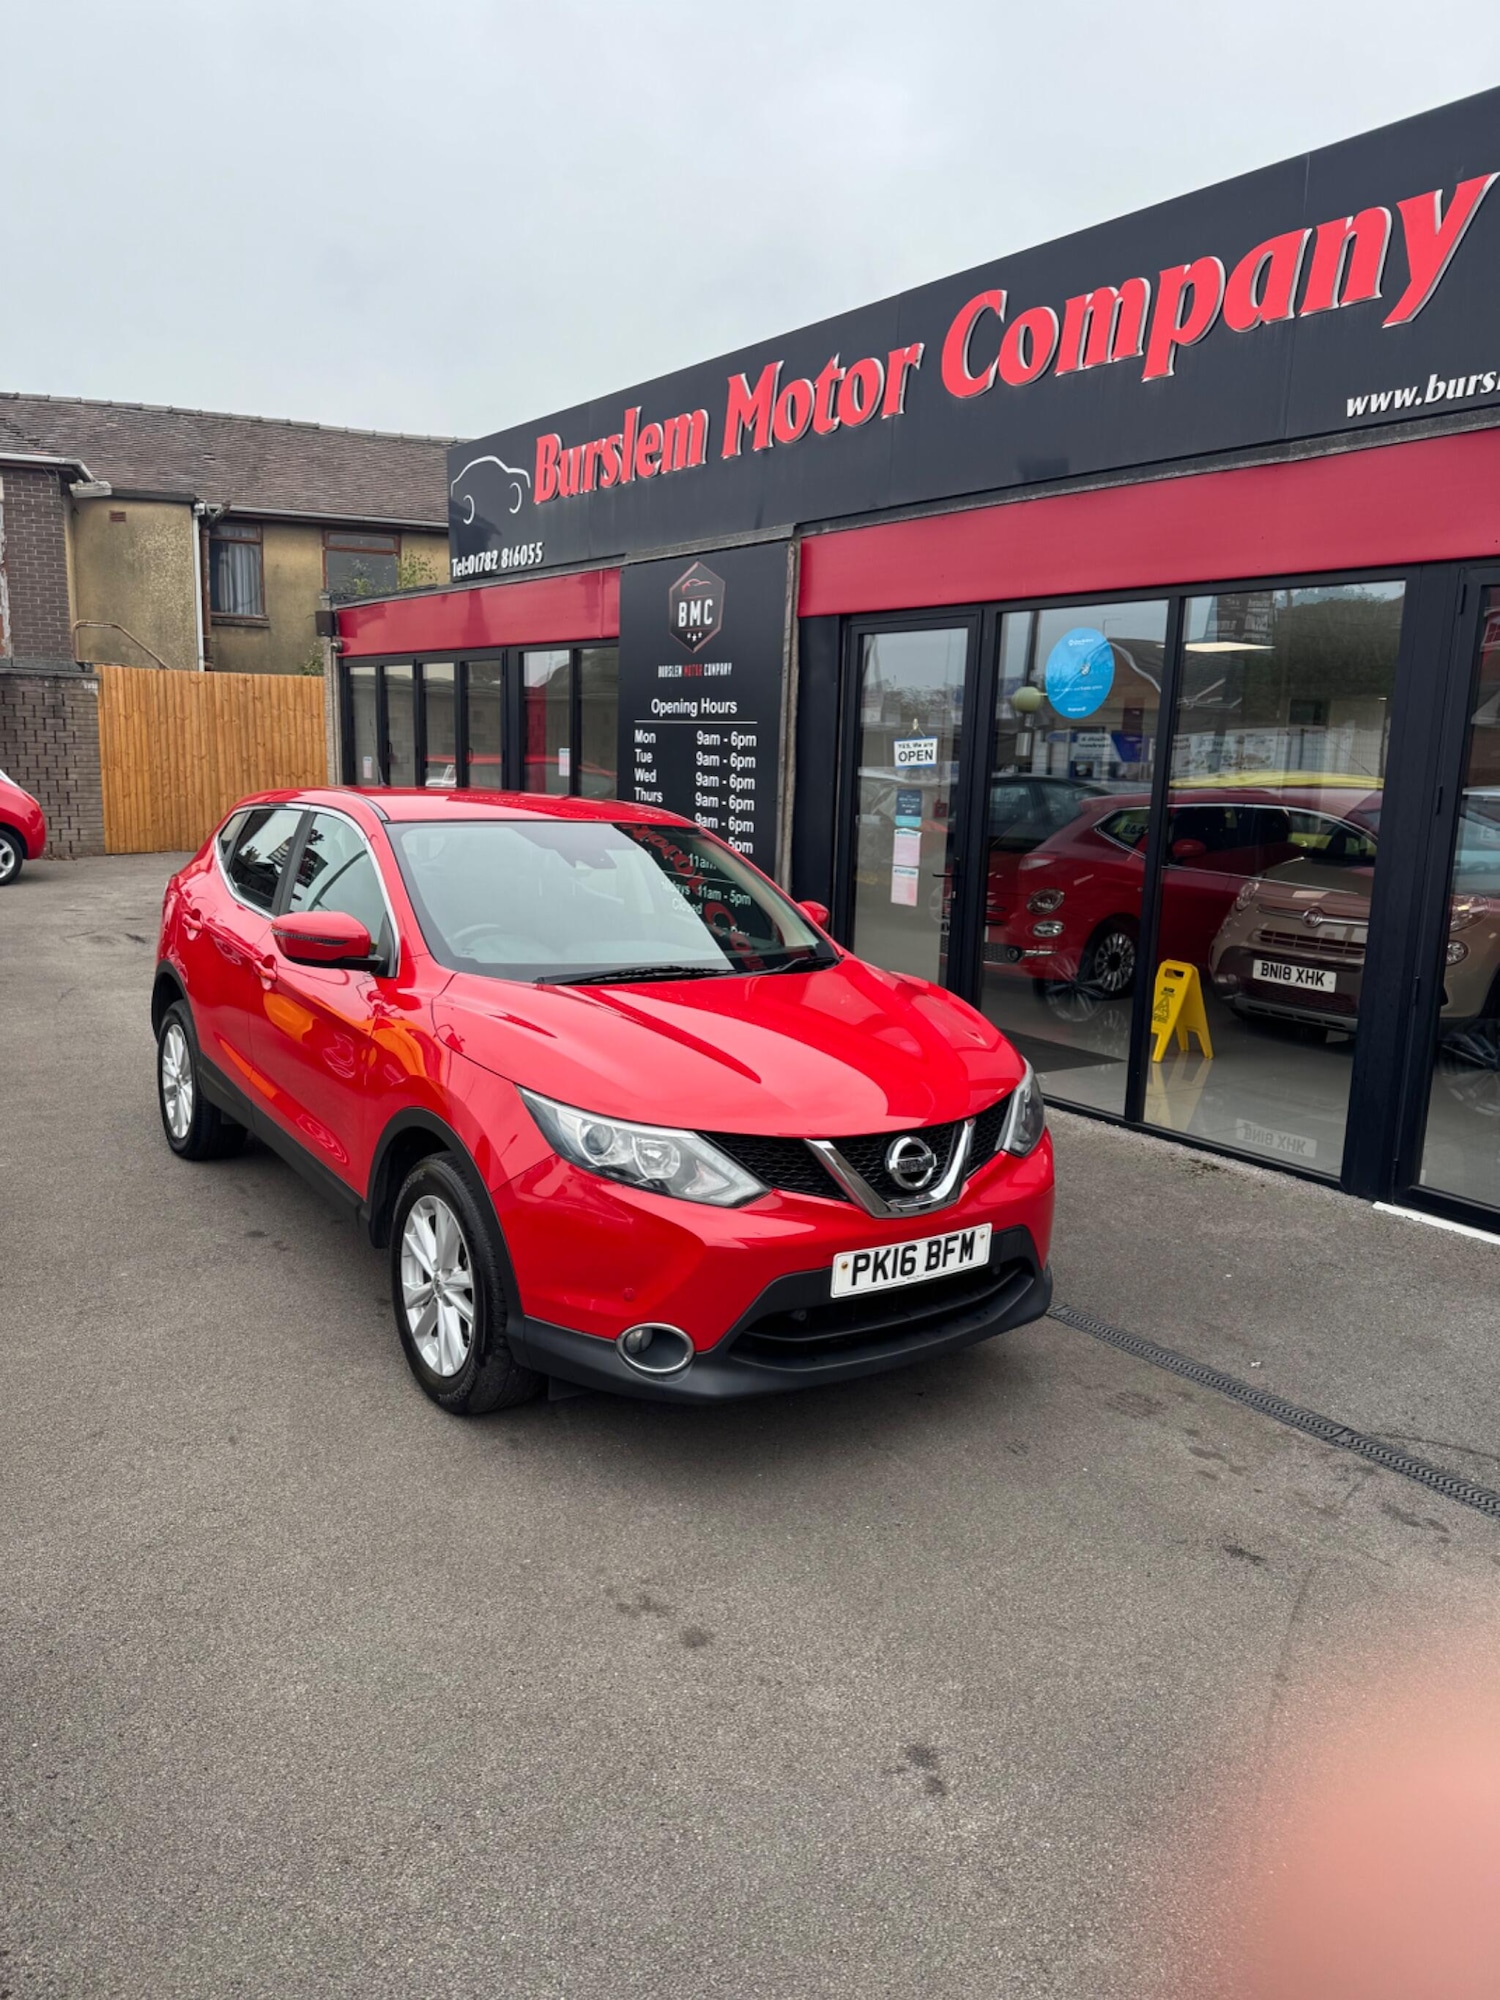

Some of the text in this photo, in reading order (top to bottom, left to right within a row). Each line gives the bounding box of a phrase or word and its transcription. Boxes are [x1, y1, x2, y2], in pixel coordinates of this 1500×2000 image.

[534, 172, 1499, 504] Burslem Motor Company
[451, 541, 543, 578] Tel:01782 816055
[678, 598, 714, 628] BMC
[651, 698, 738, 717] Opening Hours
[635, 730, 656, 744] Mon
[696, 732, 721, 747] 9am
[731, 731, 757, 749] 6pm
[635, 749, 653, 763] Tue
[696, 752, 720, 767] 9am
[730, 753, 756, 771] 6pm
[898, 749, 933, 762] OPEN
[635, 768, 657, 783] Wed
[696, 772, 719, 788] 9am
[729, 774, 755, 793] 6pm
[635, 787, 663, 803] Thurs
[695, 792, 718, 808] 9am
[729, 795, 755, 814] 6pm
[695, 813, 718, 829] 9am
[728, 817, 754, 836] 6pm
[728, 837, 753, 854] 5pm
[729, 889, 751, 907] 5pm
[1261, 962, 1326, 987] BN18 XHK
[851, 1231, 976, 1286] PK16 BFM
